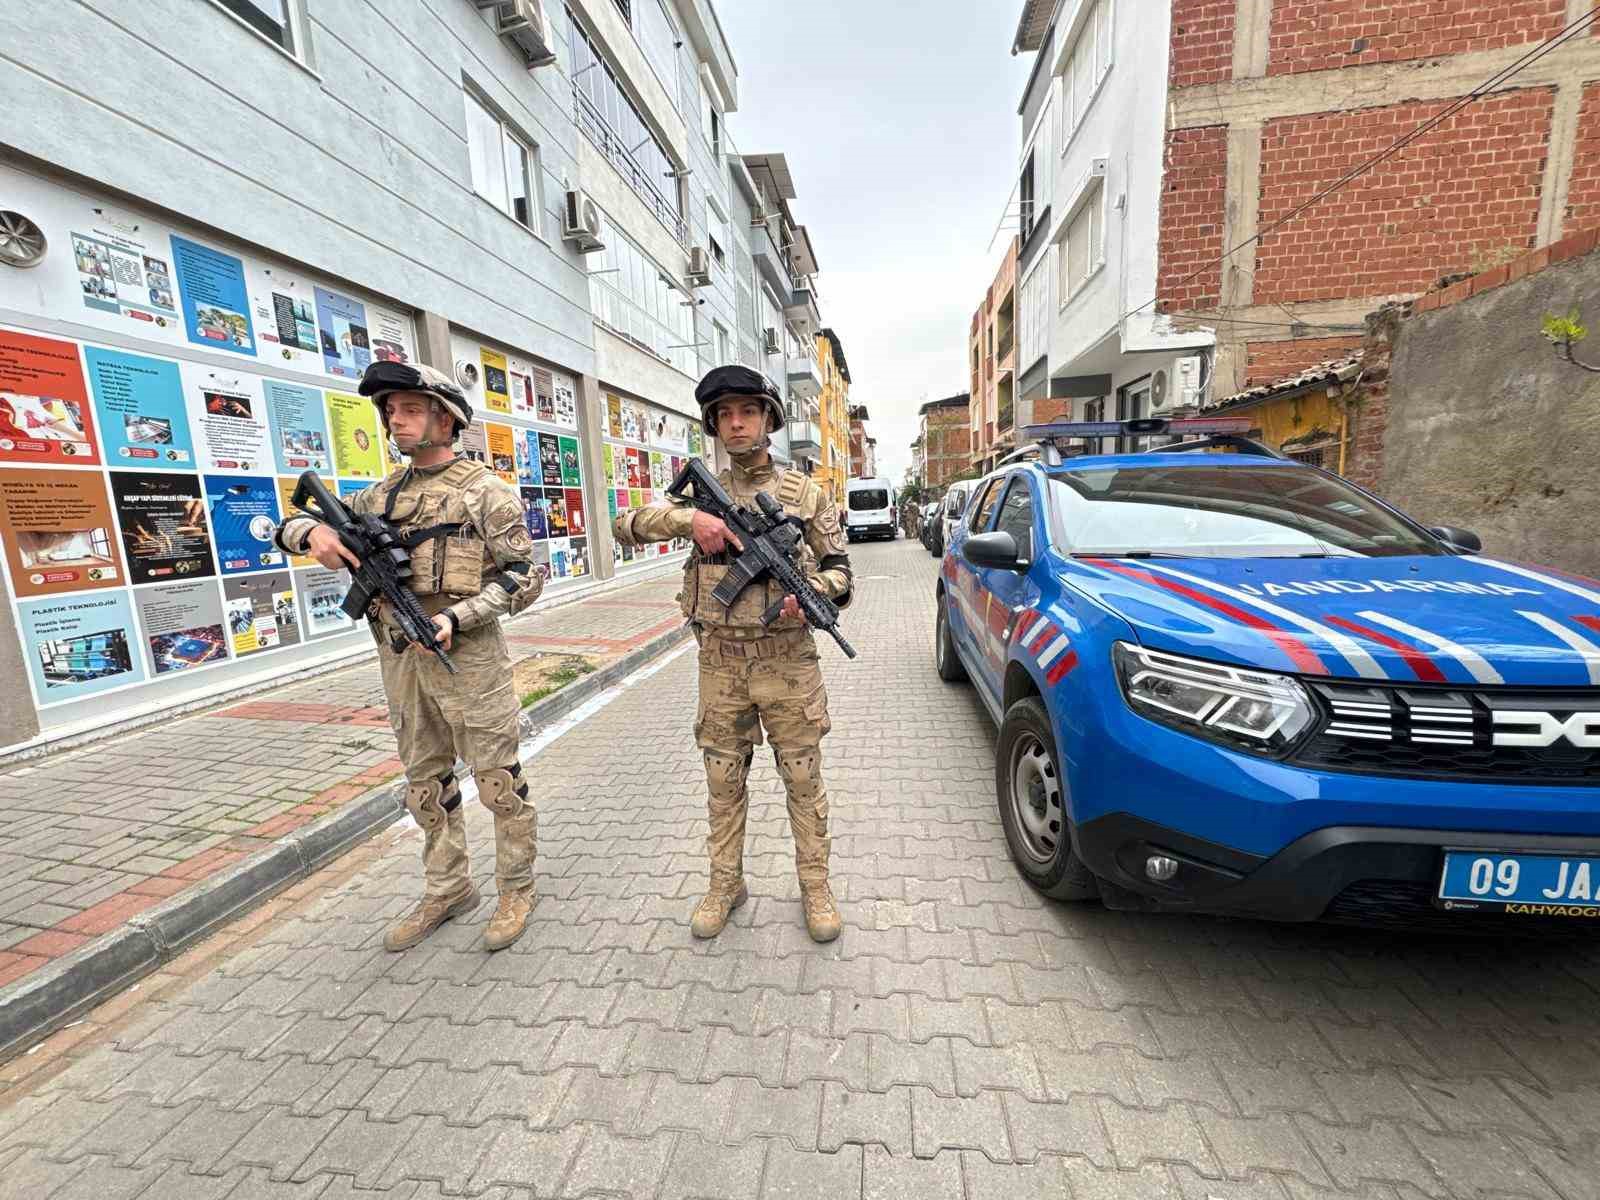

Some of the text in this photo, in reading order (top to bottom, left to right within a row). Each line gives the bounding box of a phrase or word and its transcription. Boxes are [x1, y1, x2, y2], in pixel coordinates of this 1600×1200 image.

[1240, 579, 1543, 597] JANDARMA
[32, 598, 118, 615] PLASTİK TEKNOLOJİSİ
[1468, 857, 1521, 897] 09
[1505, 903, 1600, 918] KAHYAOG
